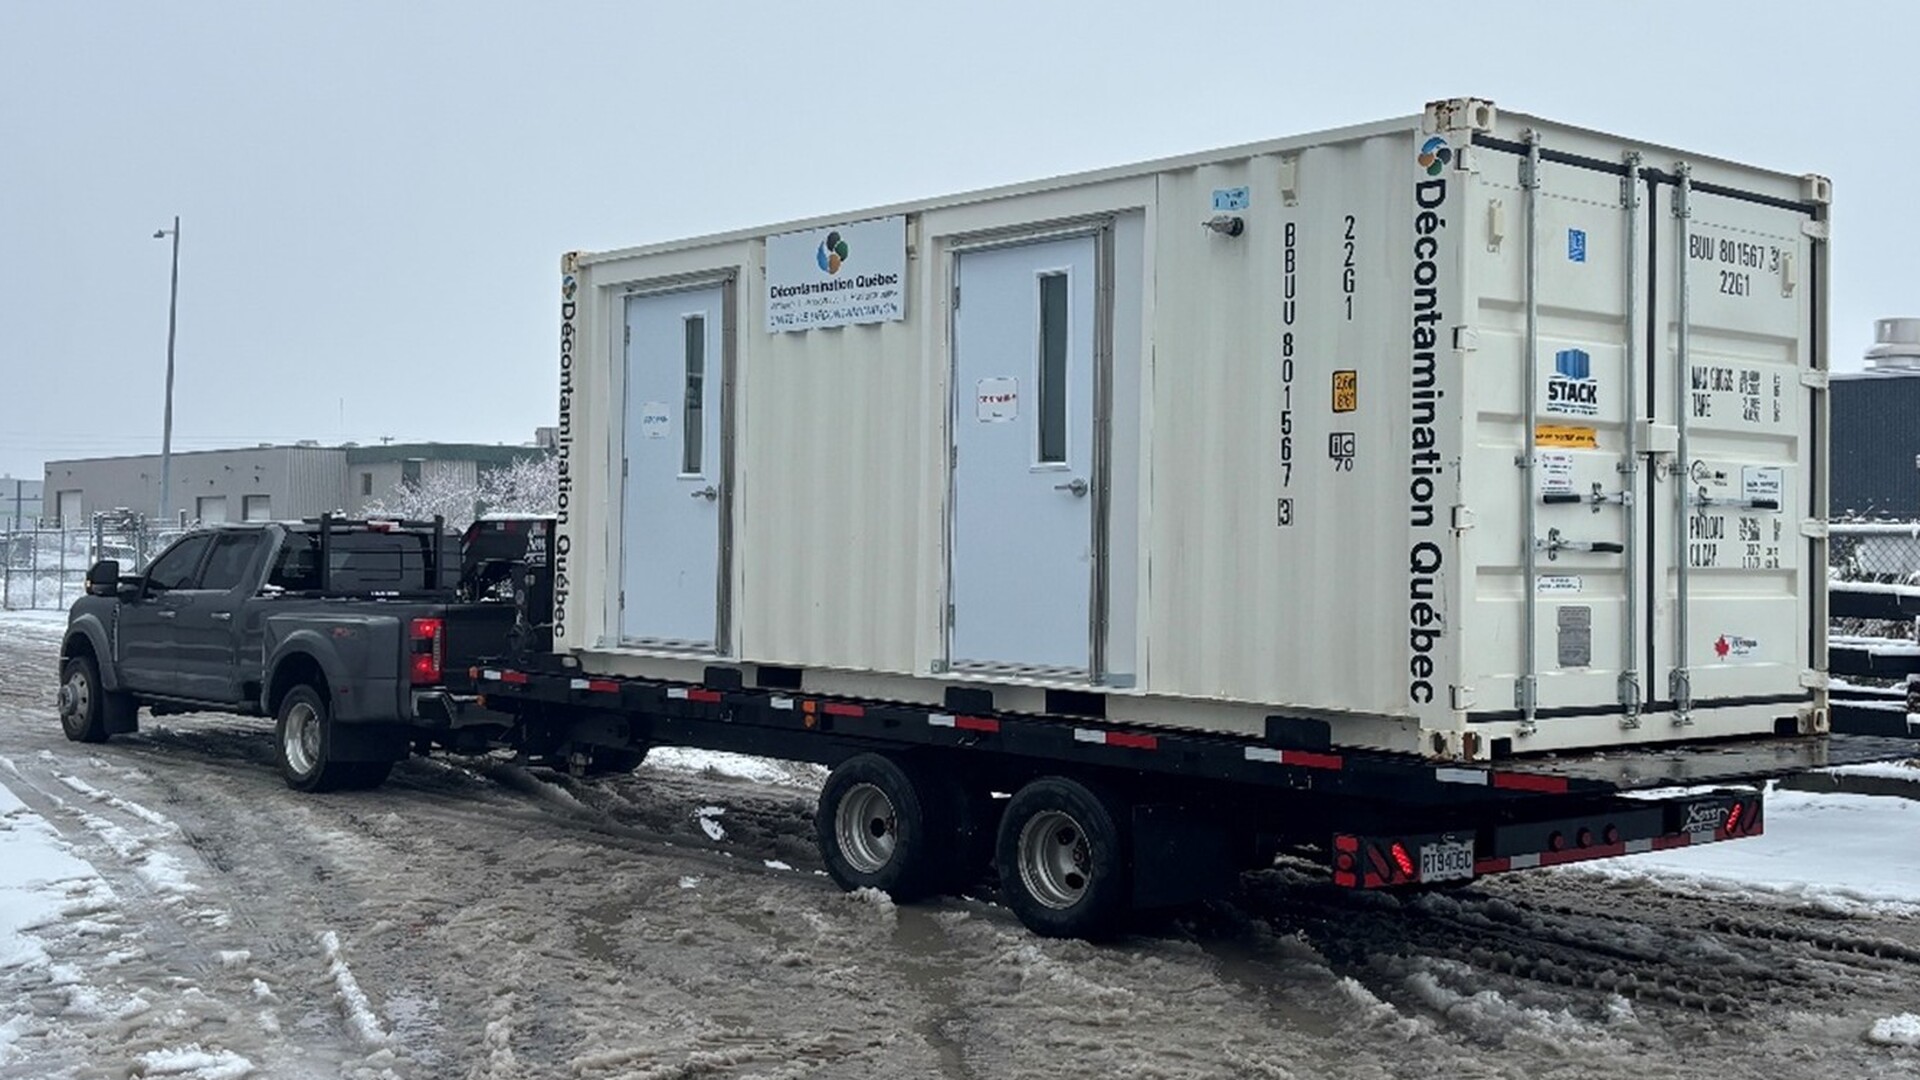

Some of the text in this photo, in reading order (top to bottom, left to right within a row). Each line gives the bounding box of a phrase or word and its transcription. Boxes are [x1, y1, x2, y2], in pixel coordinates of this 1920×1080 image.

[1690, 234, 1714, 261] BUU
[1720, 239, 1764, 269] 801567
[1343, 215, 1355, 321] 22G1
[770, 273, 899, 299] Décontamination Québec
[1720, 270, 1749, 296] 22G1
[1549, 381, 1597, 404] STACK
[1409, 178, 1447, 704] Décontamination Québec
[554, 302, 576, 638] Décontamination Québec
[1334, 458, 1354, 472] 70
[1279, 499, 1293, 526] 3
